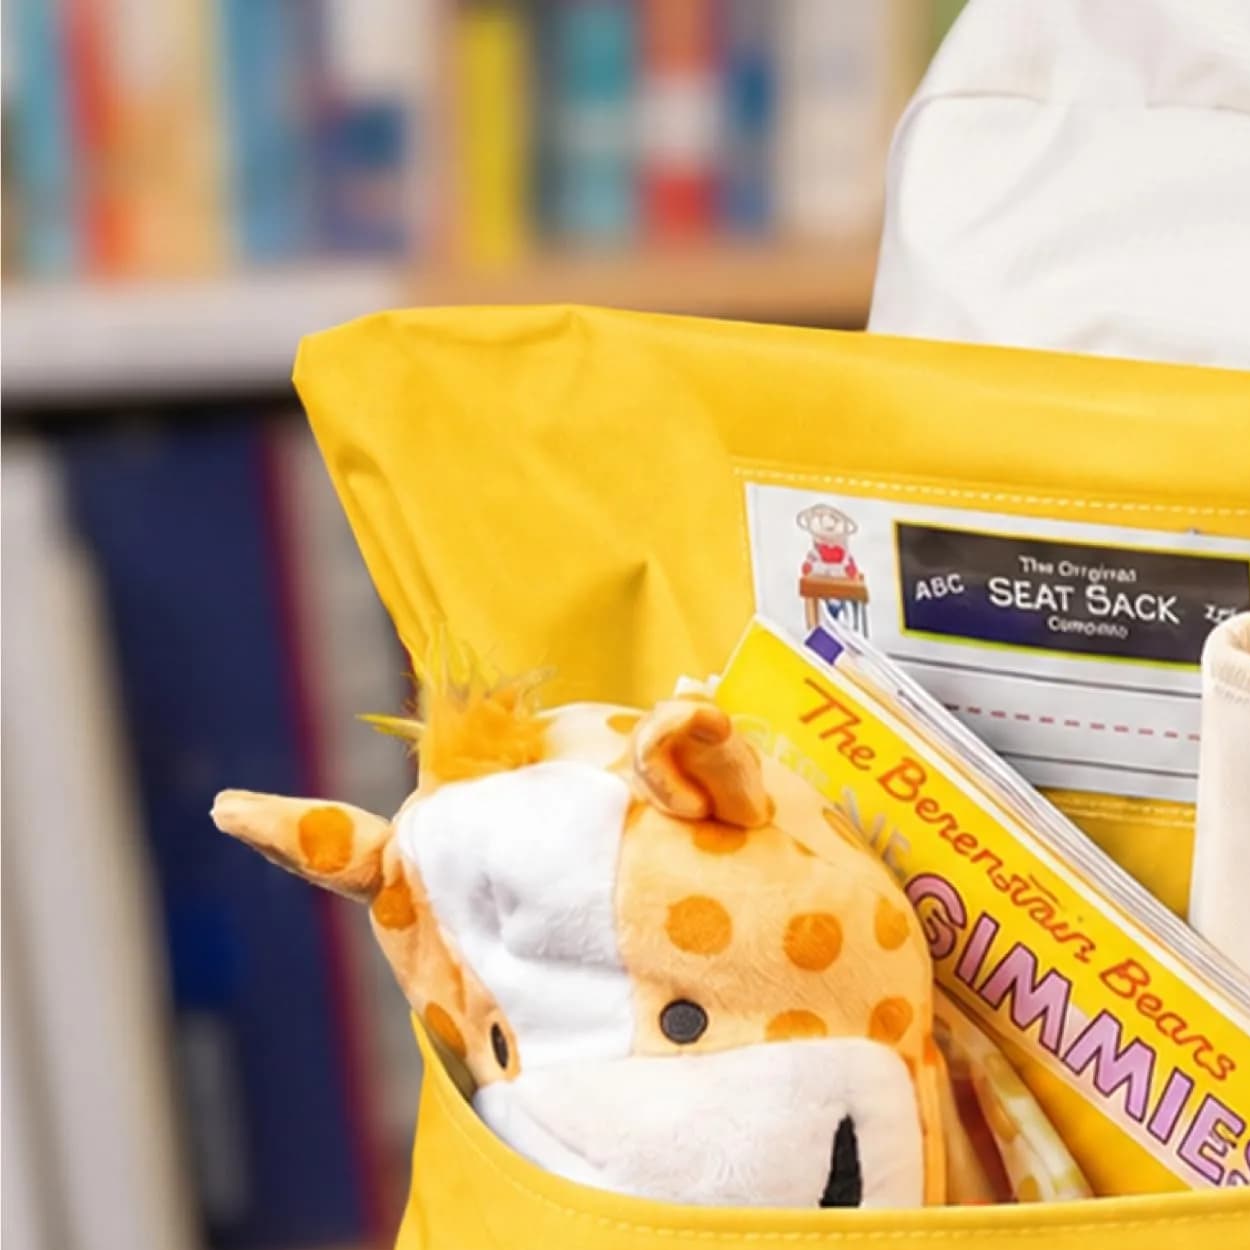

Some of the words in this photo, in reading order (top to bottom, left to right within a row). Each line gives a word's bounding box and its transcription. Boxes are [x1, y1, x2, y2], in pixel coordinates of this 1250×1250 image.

[915, 573, 964, 602] ABC
[988, 577, 1074, 612] SEAT
[1085, 584, 1180, 625] SACK
[798, 677, 876, 771] The
[876, 756, 1096, 964] Berenstain
[1099, 958, 1237, 1081] Bears
